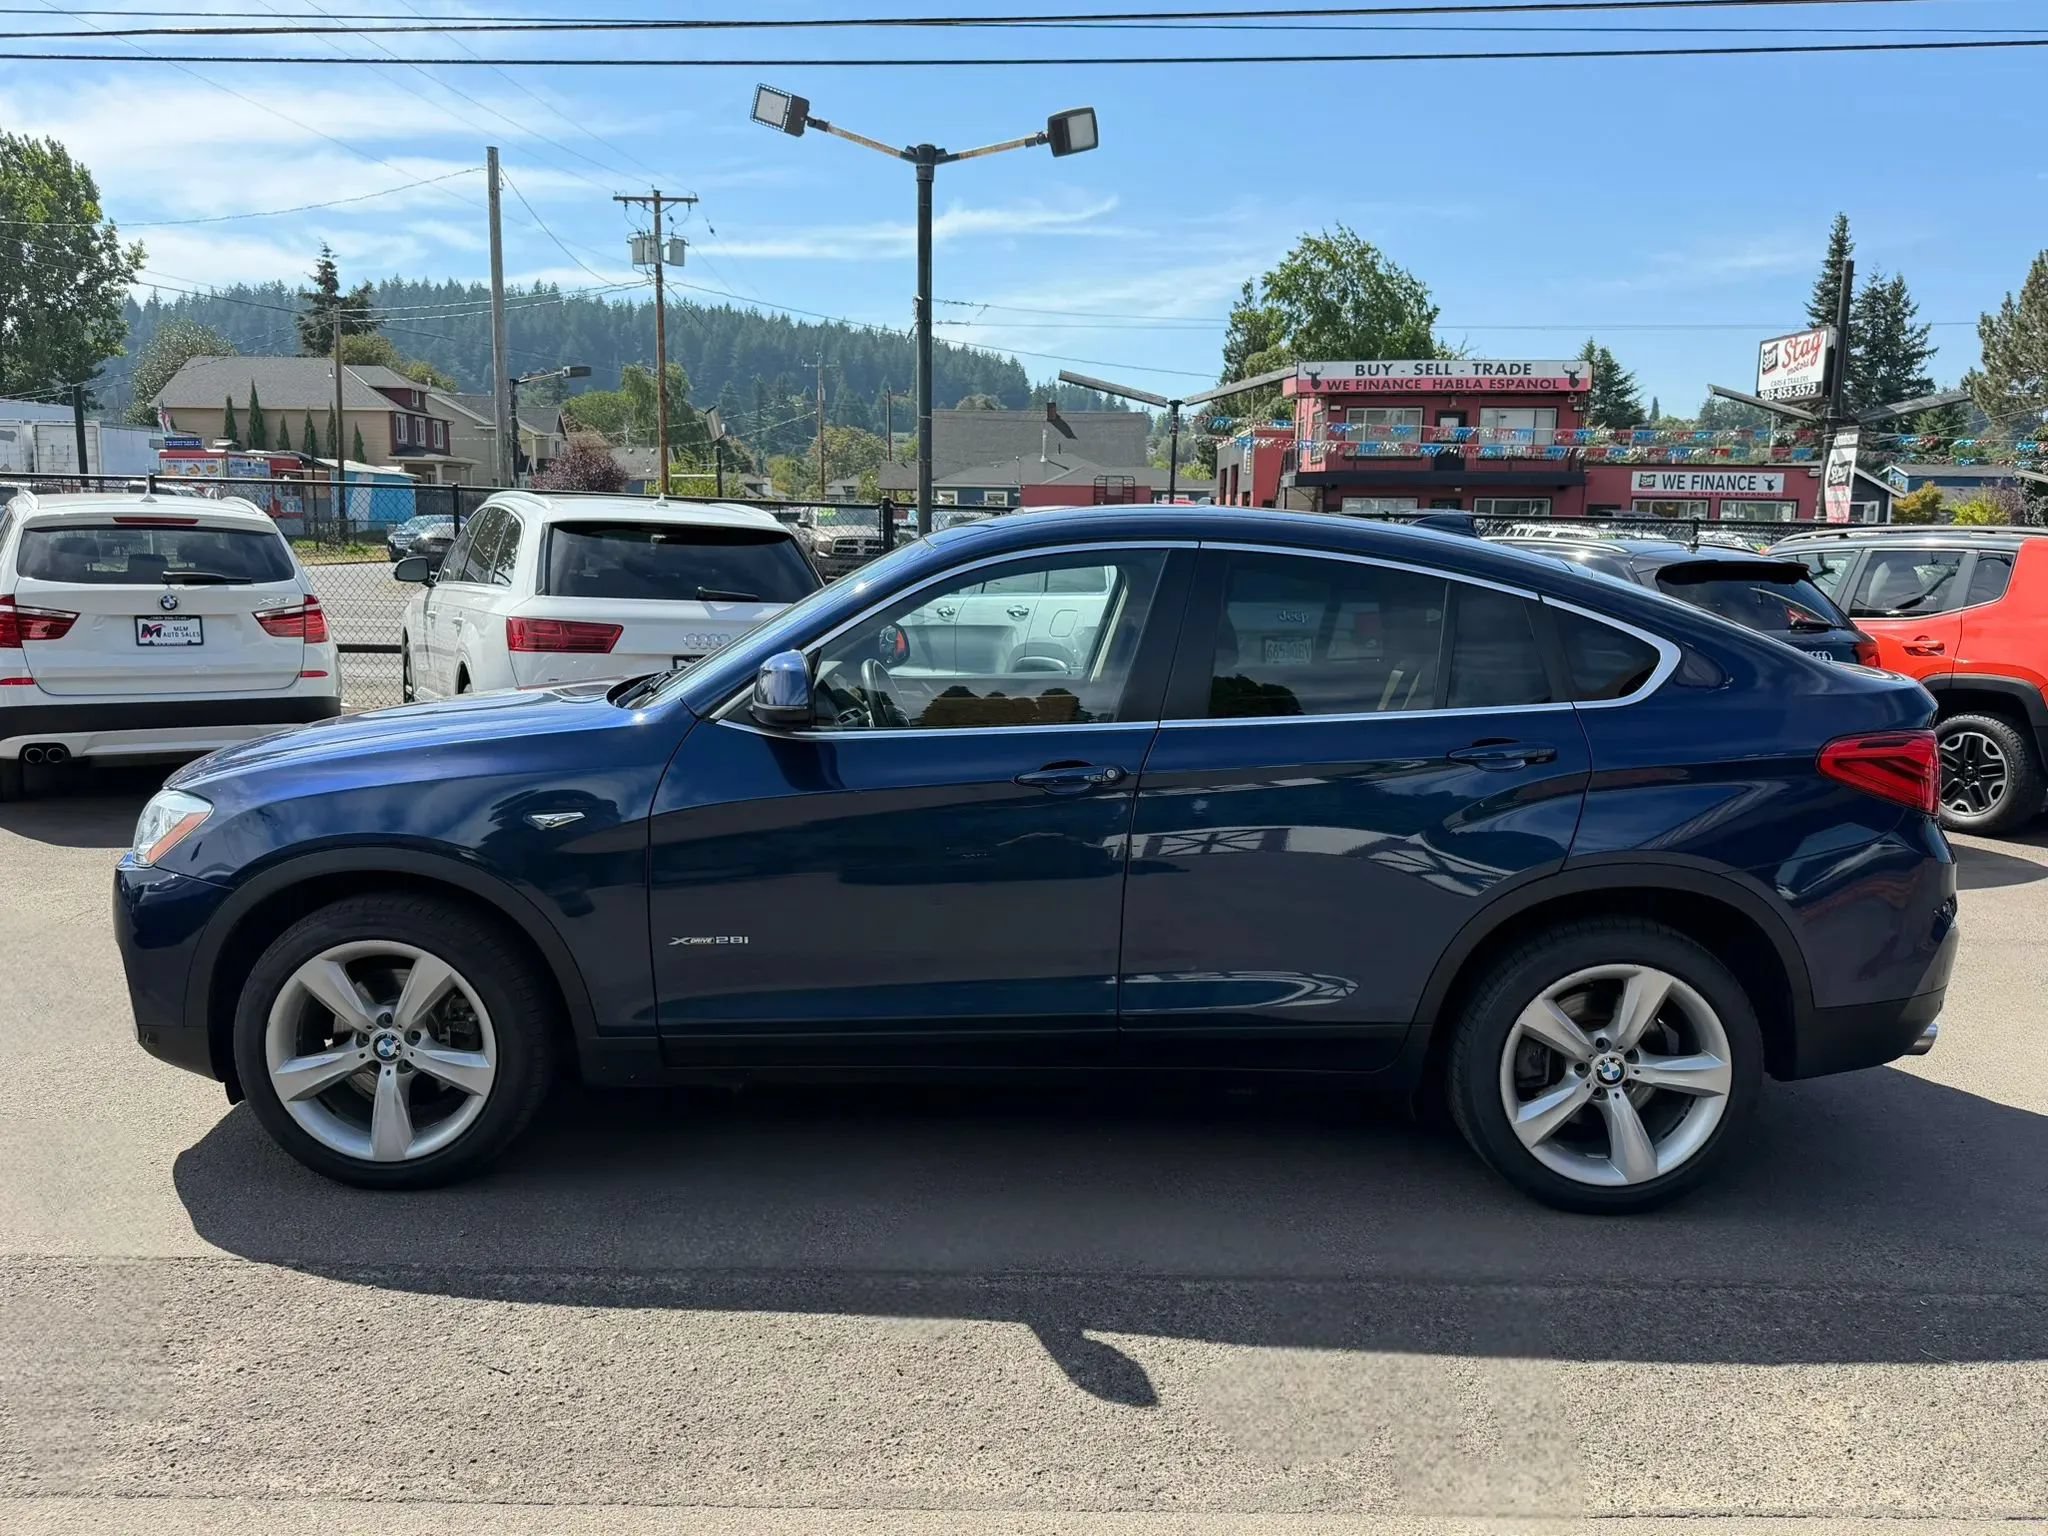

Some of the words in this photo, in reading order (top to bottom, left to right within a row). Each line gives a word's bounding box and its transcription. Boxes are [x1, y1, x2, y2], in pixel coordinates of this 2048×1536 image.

[1782, 331, 1824, 368] Stag
[1355, 363, 1393, 377] BUY
[1413, 362, 1452, 376] SELL
[1472, 362, 1532, 376] TRADE
[1327, 380, 1350, 391] WE
[1356, 379, 1421, 390] FINANCE
[1433, 379, 1483, 389] HABLA
[1490, 378, 1559, 390] ESPANOL
[1662, 474, 1686, 489] WE
[1691, 475, 1757, 491] FINANCE
[1279, 609, 1309, 623] Jeep
